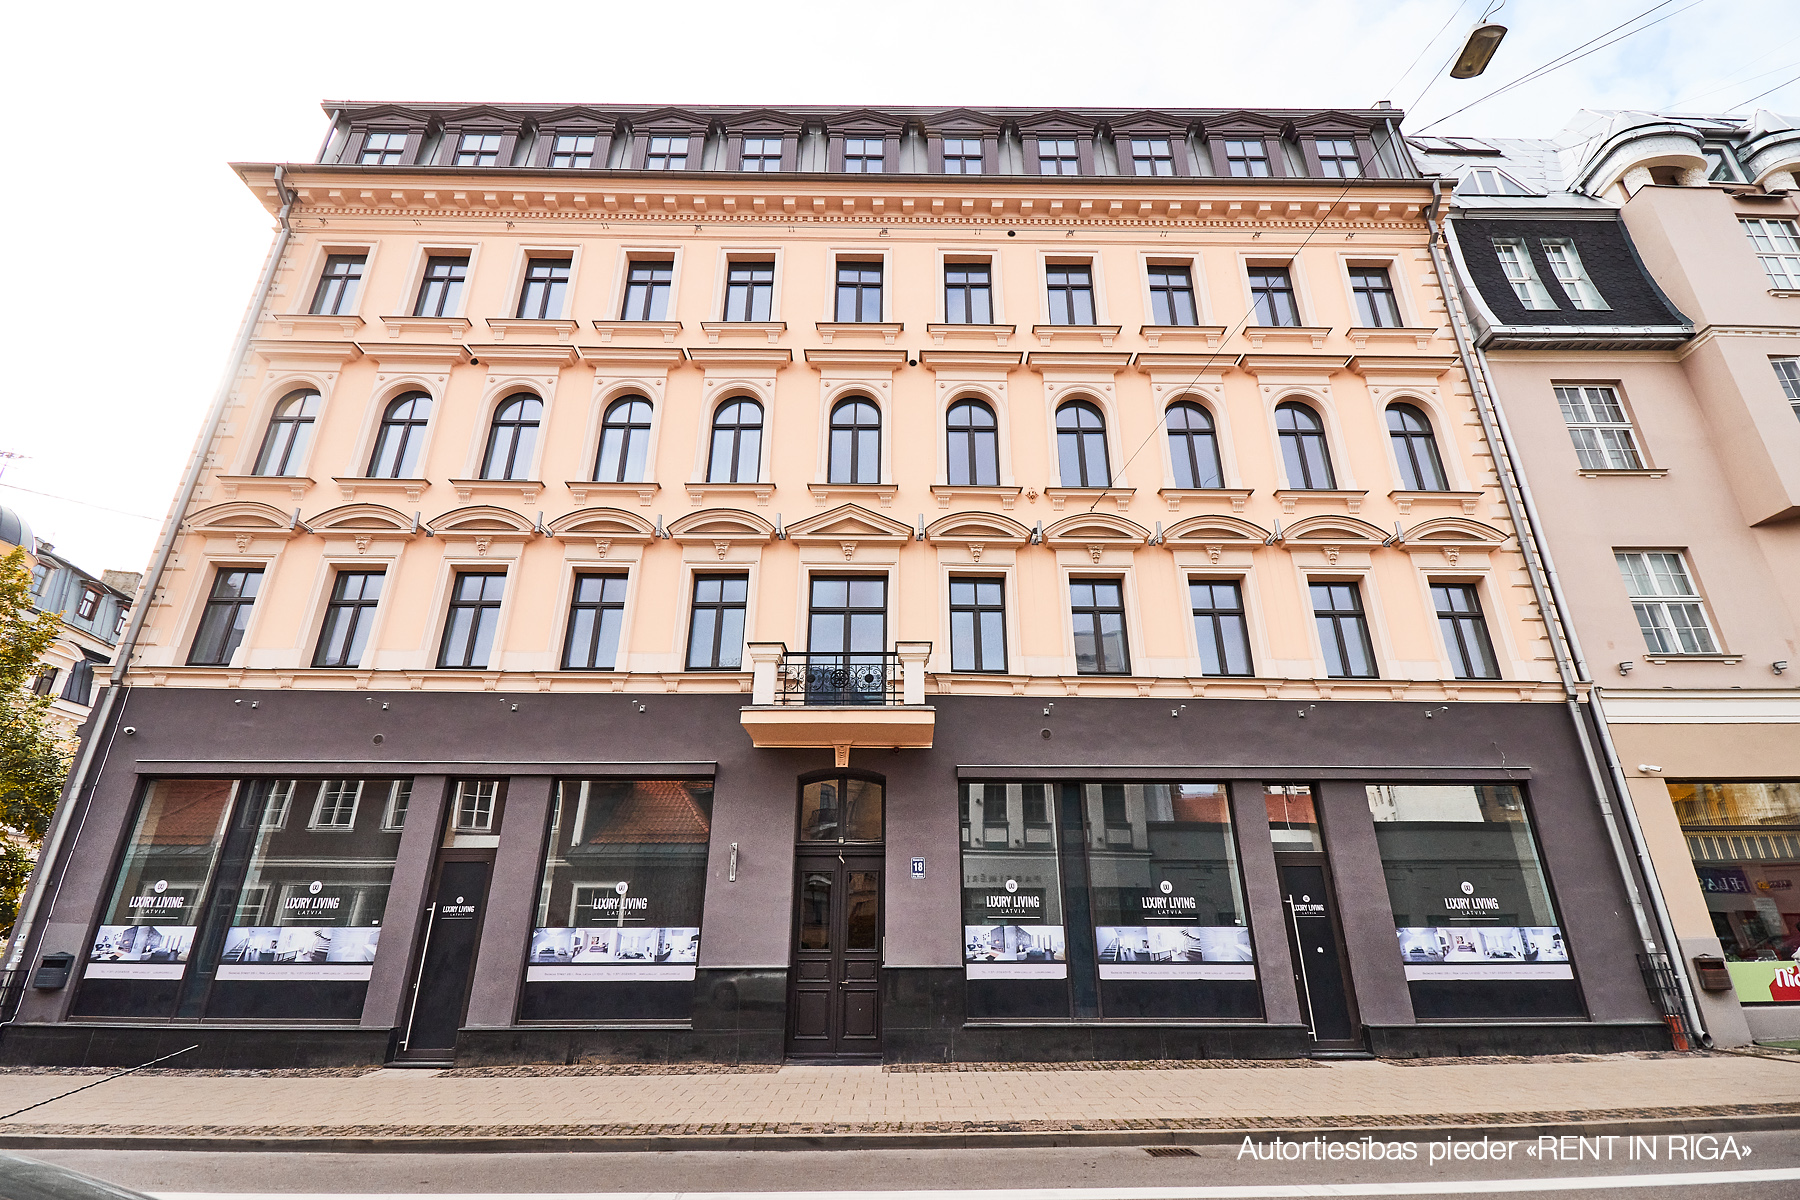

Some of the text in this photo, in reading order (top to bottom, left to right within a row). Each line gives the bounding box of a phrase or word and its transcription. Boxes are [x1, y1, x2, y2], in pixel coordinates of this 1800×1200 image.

[913, 862, 923, 872] 18
[129, 896, 184, 908] LUXURY LIVING
[285, 897, 340, 909] LUXURY LIVING
[593, 897, 648, 910] LUXURY LIVING
[986, 895, 1040, 908] LUXURY LIVING
[1141, 896, 1196, 909] LUXURY LIVING
[1444, 897, 1500, 909] LUXURY LIVING
